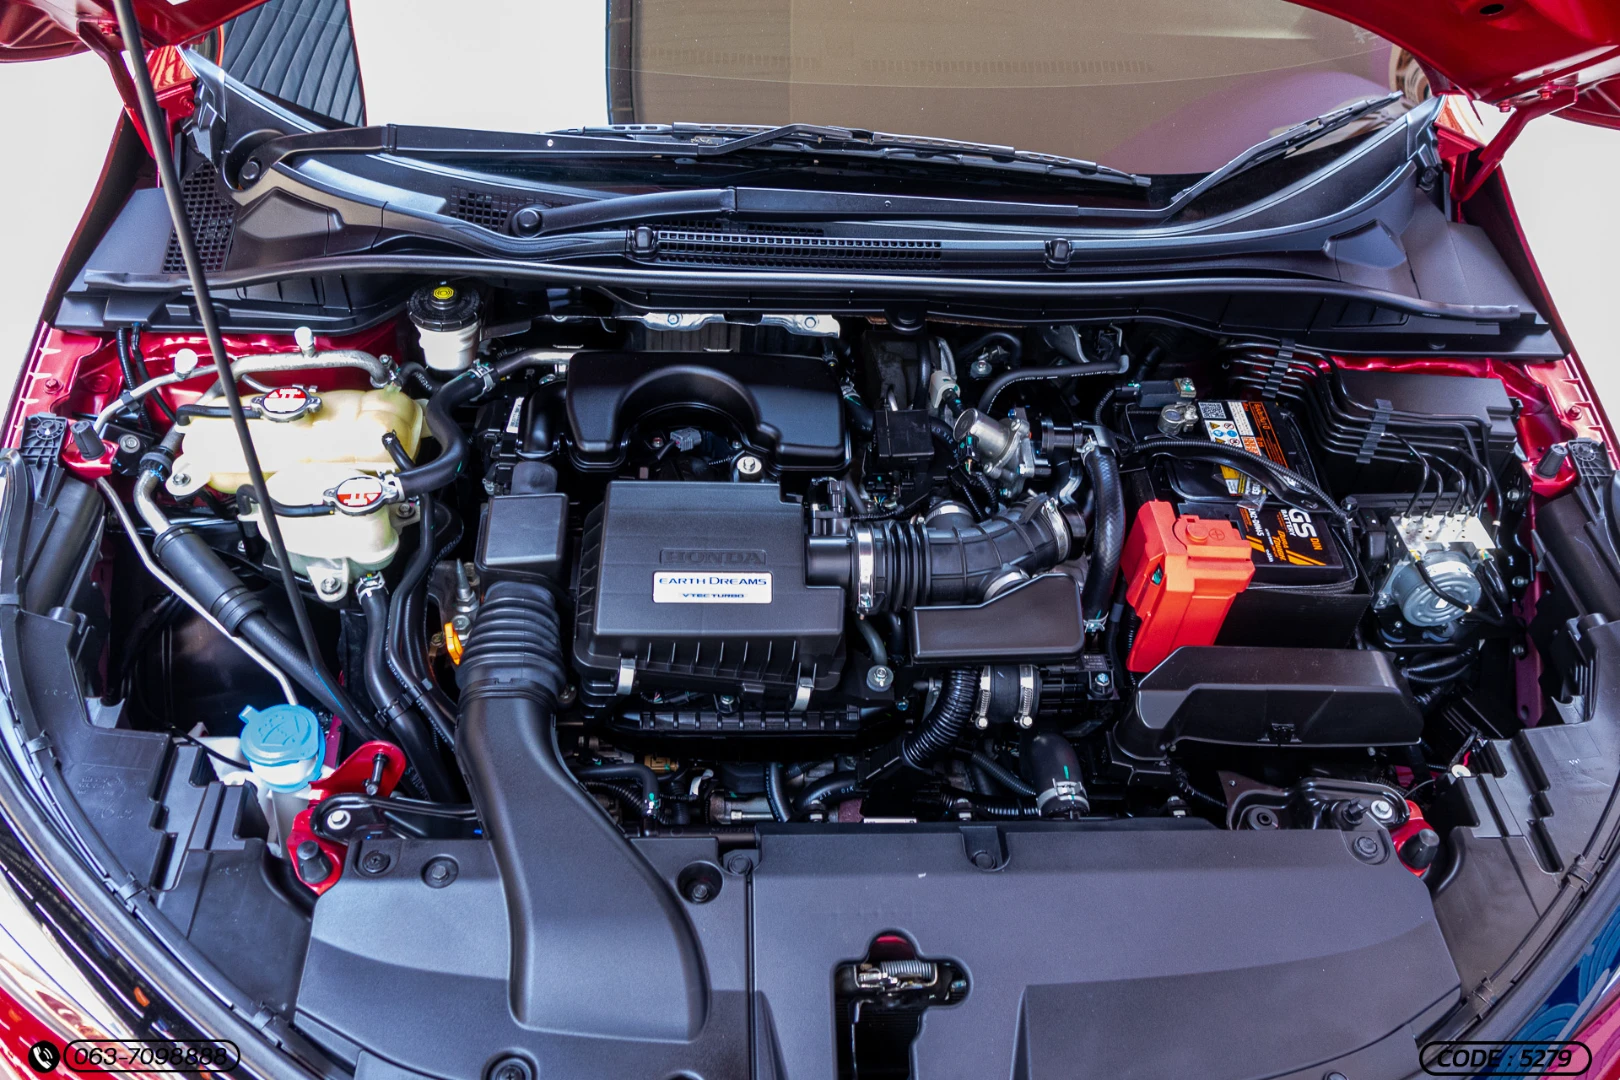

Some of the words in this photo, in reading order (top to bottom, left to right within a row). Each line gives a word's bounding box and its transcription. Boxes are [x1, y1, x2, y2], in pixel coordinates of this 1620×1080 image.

[1280, 508, 1296, 537] BATTERY
[1288, 508, 1317, 538] GS
[1310, 537, 1323, 551] DIN
[666, 551, 763, 564] HONDA
[659, 577, 706, 585] EARTH
